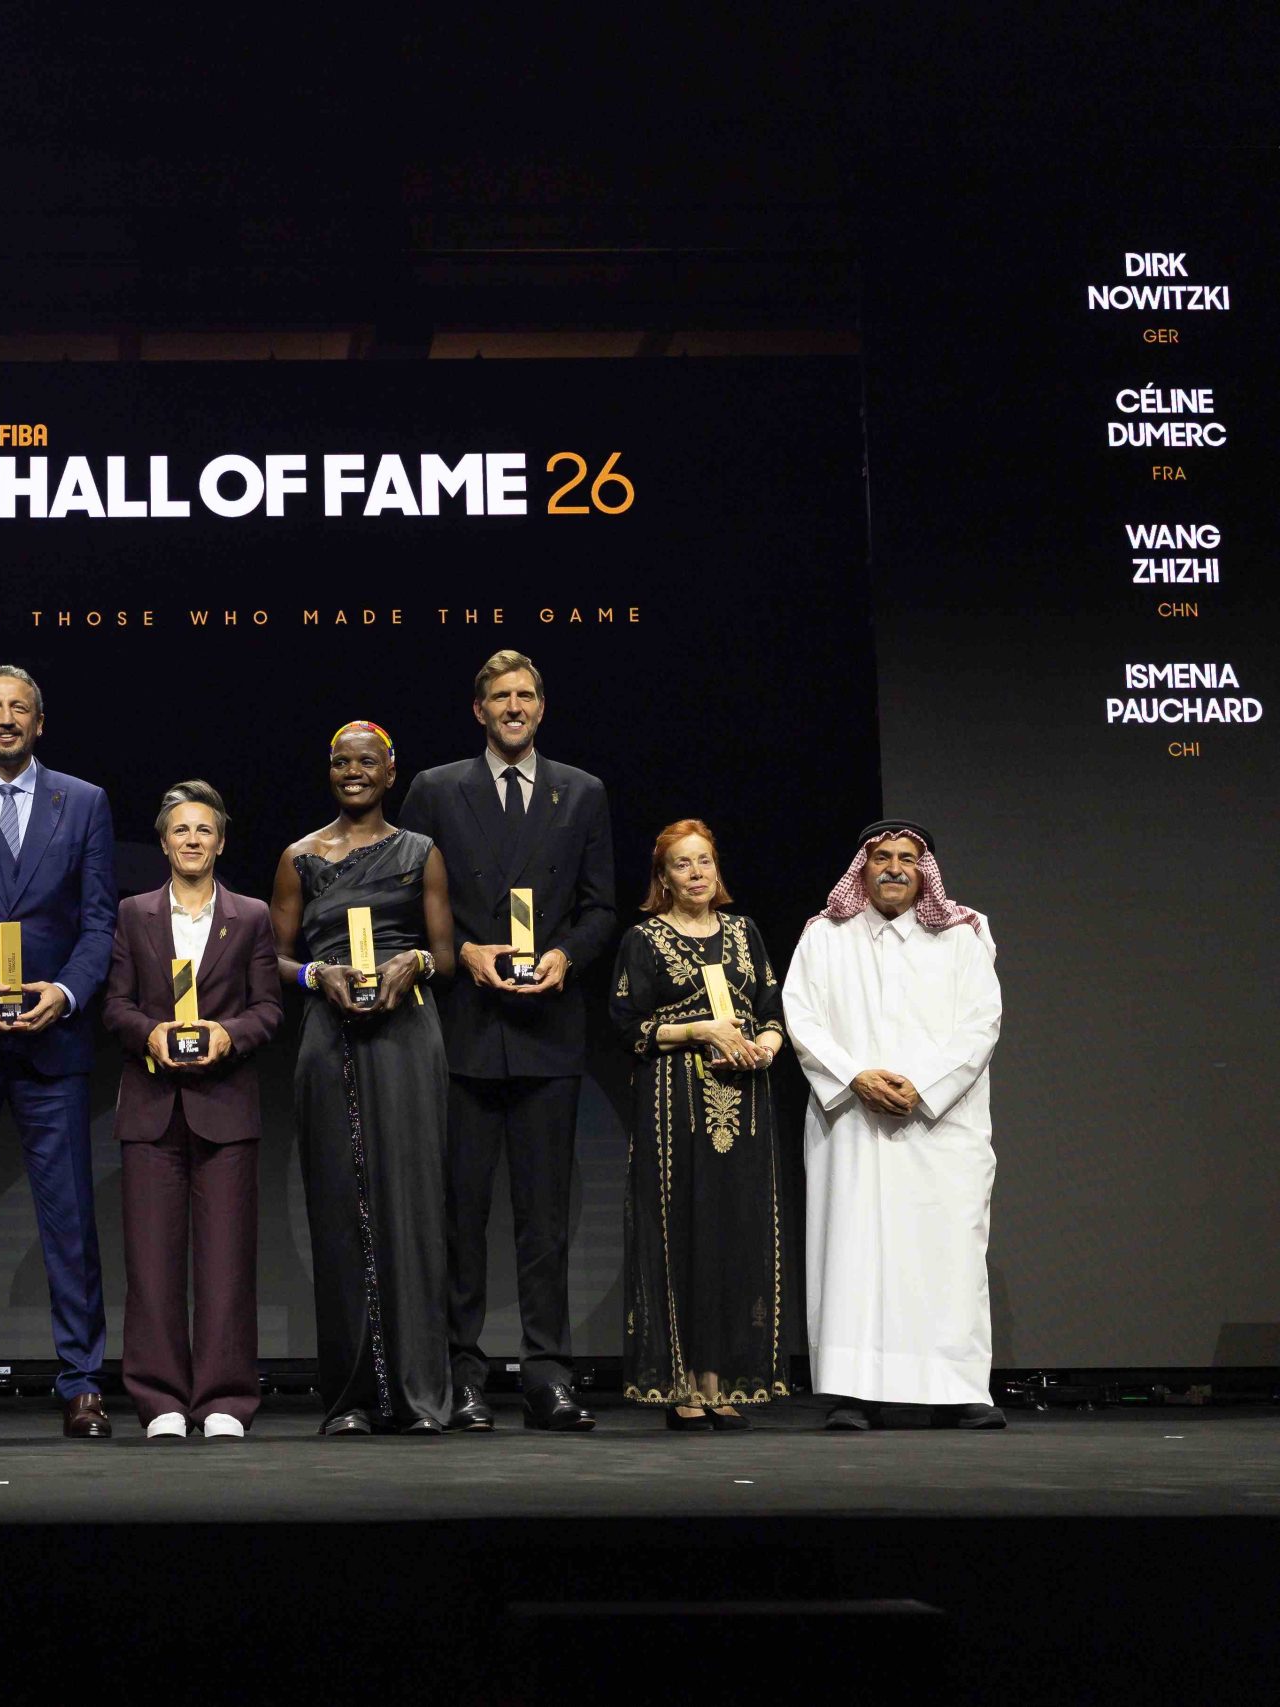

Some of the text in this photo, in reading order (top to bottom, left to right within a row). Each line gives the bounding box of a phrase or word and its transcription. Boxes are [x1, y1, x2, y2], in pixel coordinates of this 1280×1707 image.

[1125, 253, 1188, 276] DIRK
[1088, 286, 1229, 310] NOWITZKI
[1144, 329, 1178, 342] GER
[1116, 382, 1214, 413] CÉLINE
[0, 424, 47, 446] FIBA
[1108, 422, 1226, 446] DUMERC
[199, 454, 307, 517] OF
[324, 453, 527, 516] FAME
[547, 452, 634, 514] 26
[1153, 466, 1186, 480] FRA
[1125, 525, 1221, 549] WANG
[1132, 558, 1219, 583] ZHIZHI
[32, 611, 152, 626] THOSE
[191, 611, 267, 625] WHO
[304, 610, 401, 624] MADE
[439, 609, 503, 623] THE
[540, 608, 639, 622] GAME
[1158, 603, 1198, 617] CHN
[1126, 663, 1240, 688] ISMENIA
[1107, 698, 1263, 723] PAUCHARD
[1169, 742, 1199, 756] CHI
